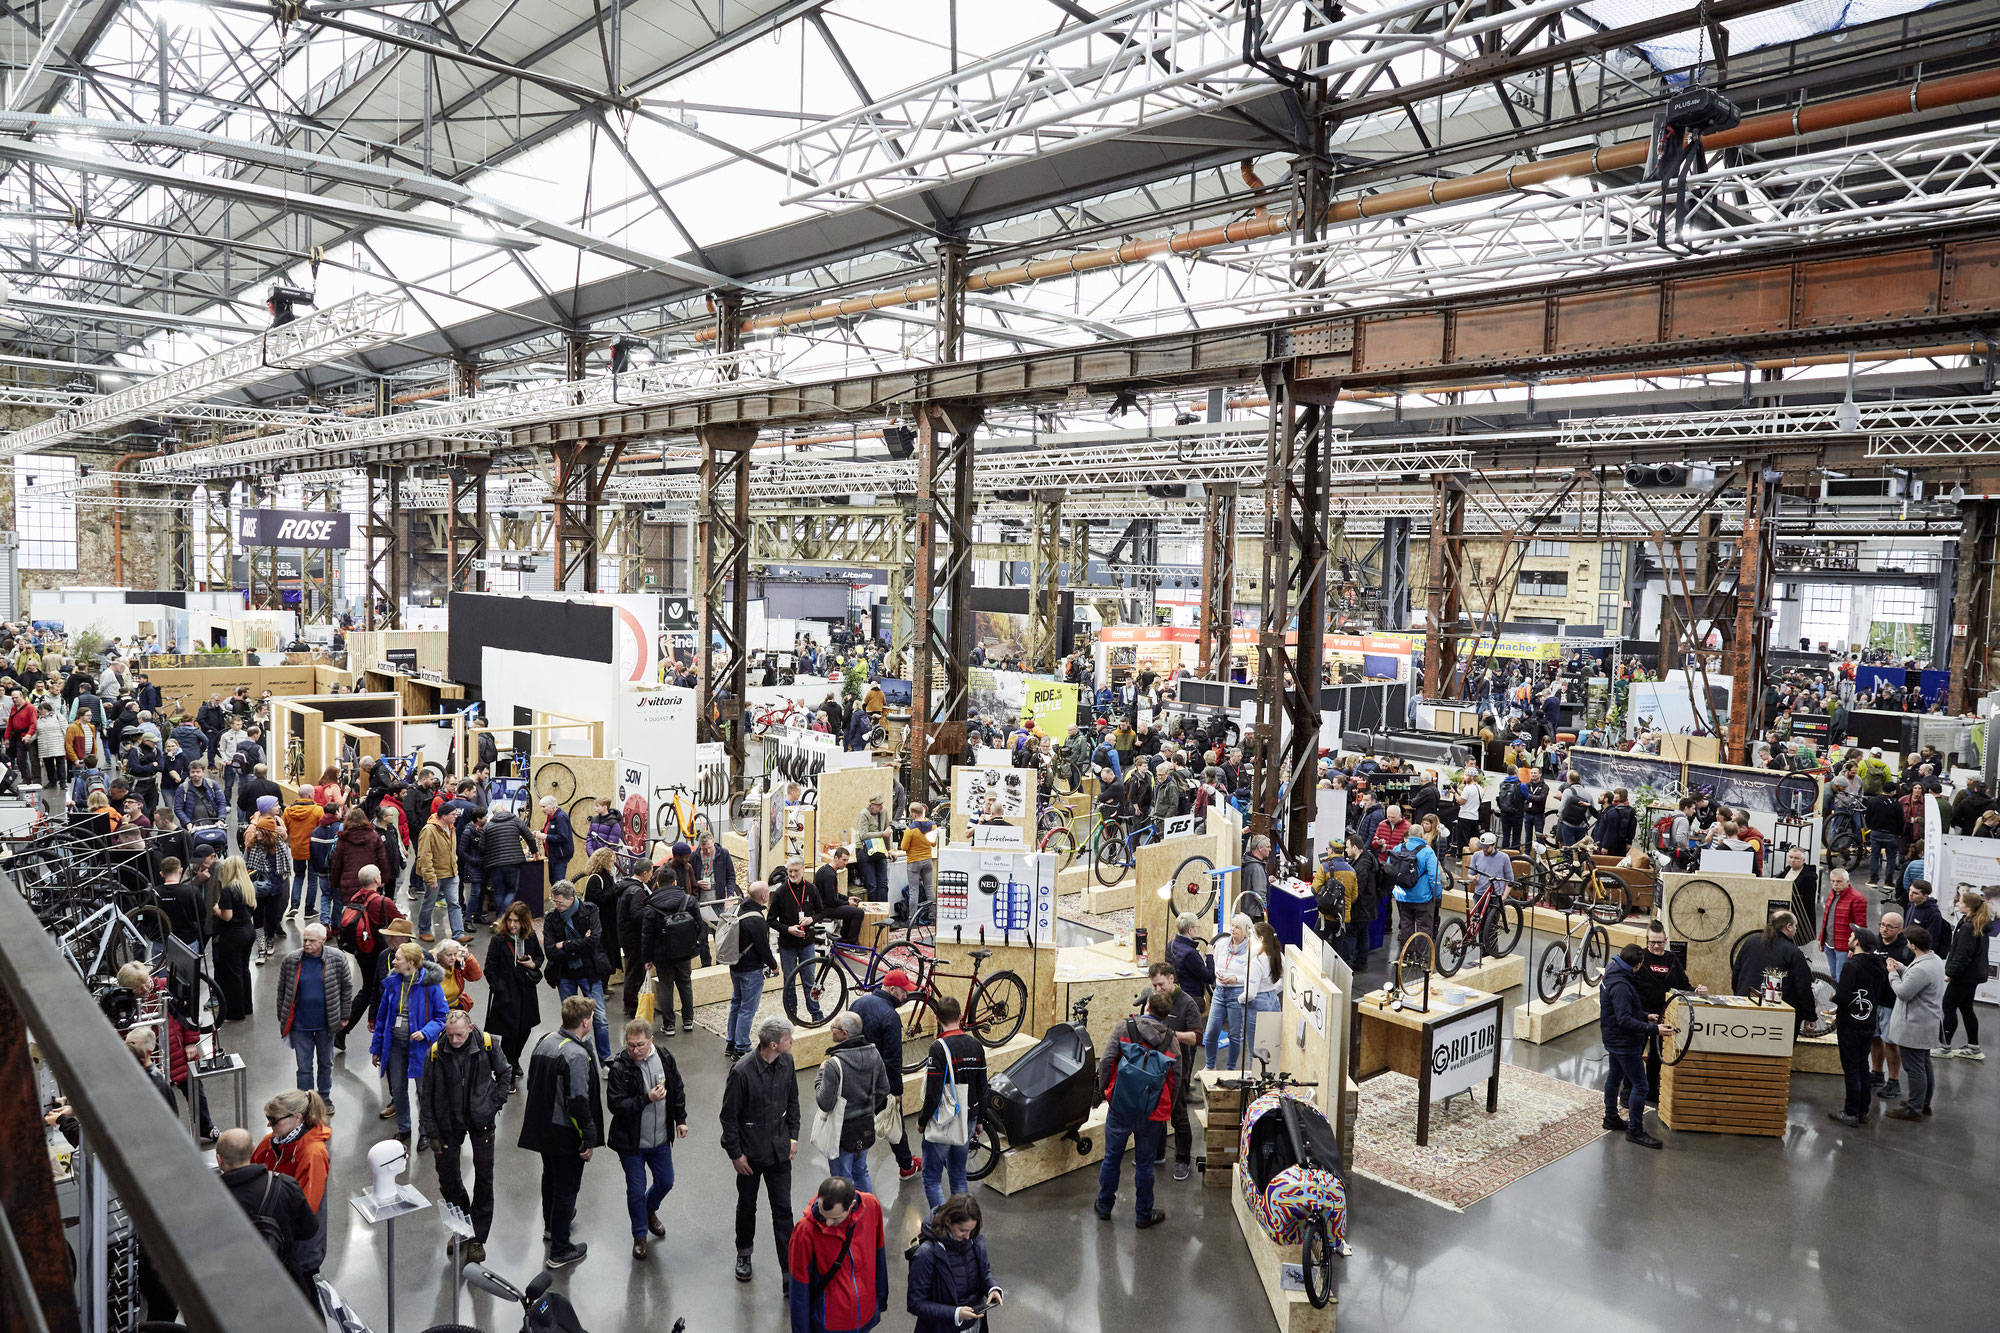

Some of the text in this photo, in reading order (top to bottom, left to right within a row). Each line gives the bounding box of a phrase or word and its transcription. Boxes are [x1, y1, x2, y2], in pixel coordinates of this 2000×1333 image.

[241, 517, 257, 538] ROSE
[277, 519, 337, 540] ROSE
[648, 695, 683, 706] vittoria
[1034, 689, 1055, 703] RIDE
[1034, 699, 1062, 713] STYLE
[1166, 819, 1192, 835] SES
[980, 880, 998, 888] NEU
[1450, 1024, 1495, 1063] ROTOR
